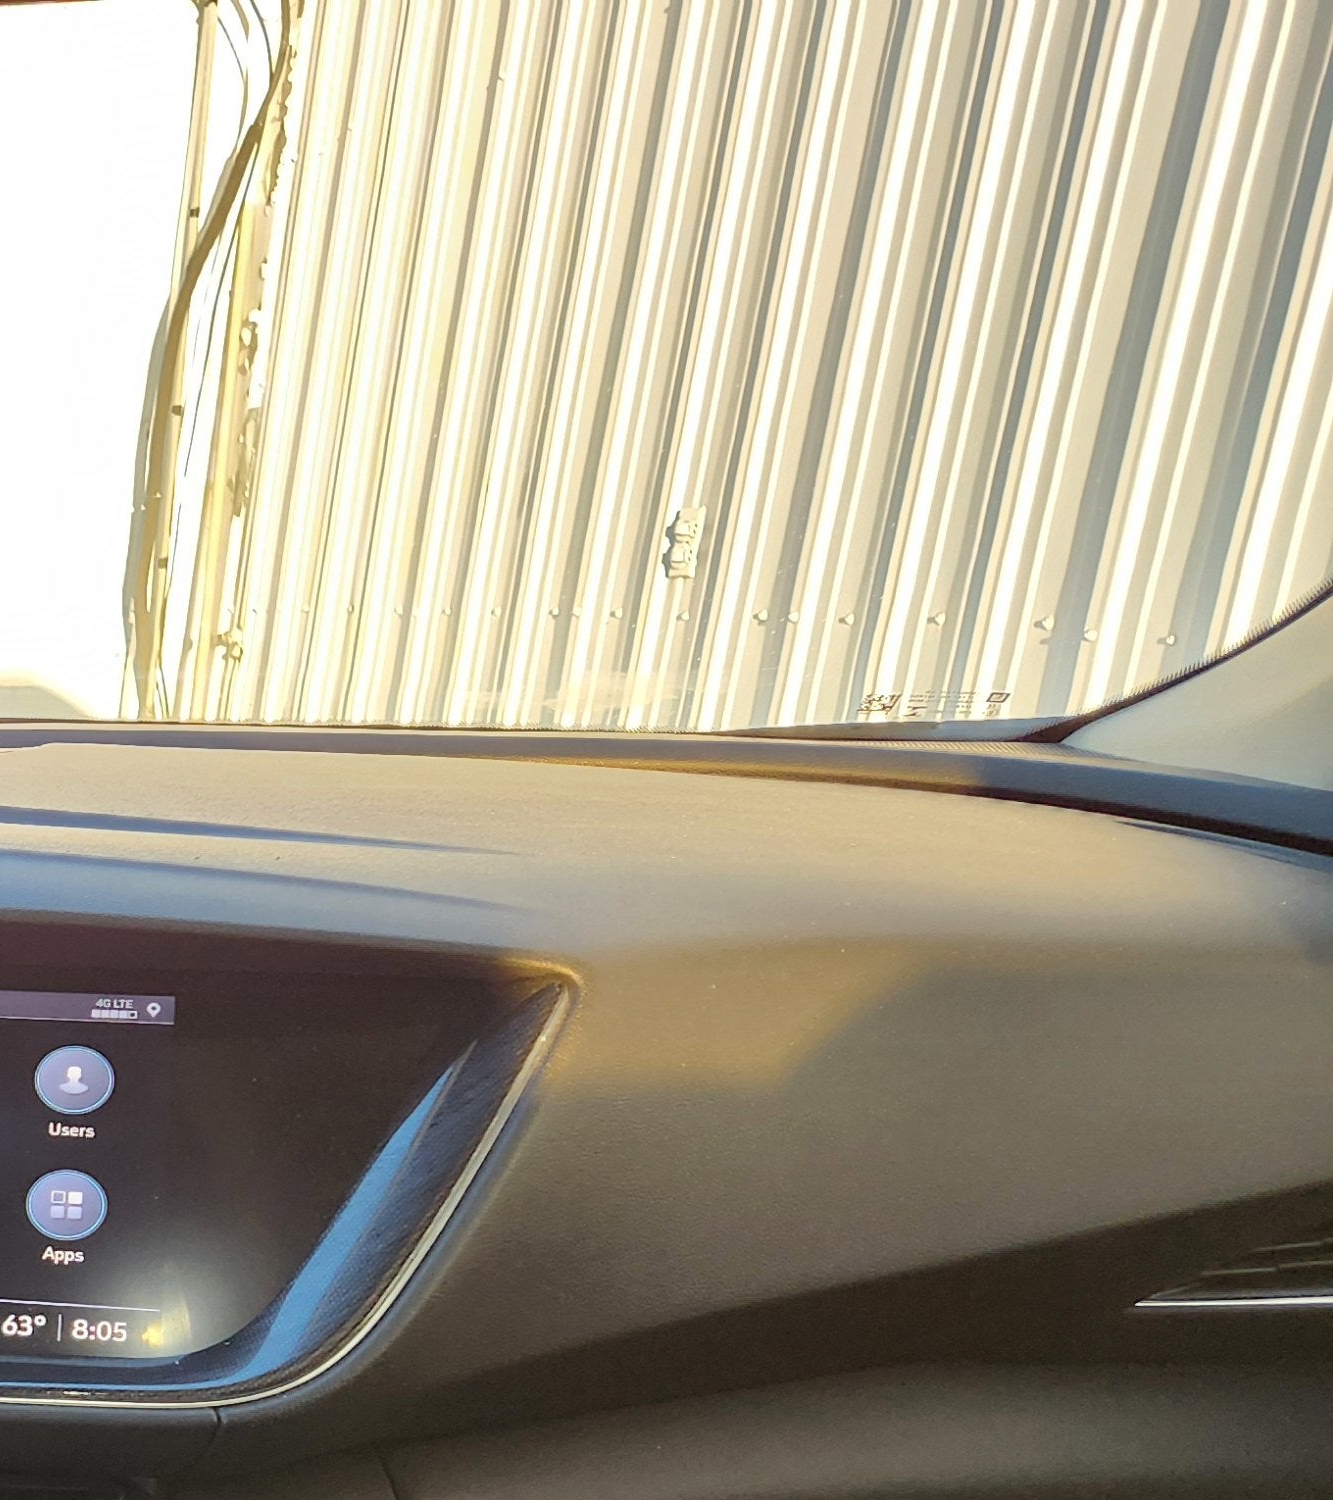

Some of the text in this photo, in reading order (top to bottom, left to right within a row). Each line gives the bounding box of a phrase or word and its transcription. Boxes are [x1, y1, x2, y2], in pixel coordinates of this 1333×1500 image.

[95, 998, 134, 1009] 4G LTE
[48, 1122, 96, 1138] Users
[41, 1246, 85, 1265] Apps
[0, 1313, 48, 1337] 63°
[71, 1319, 128, 1342] 8:05
